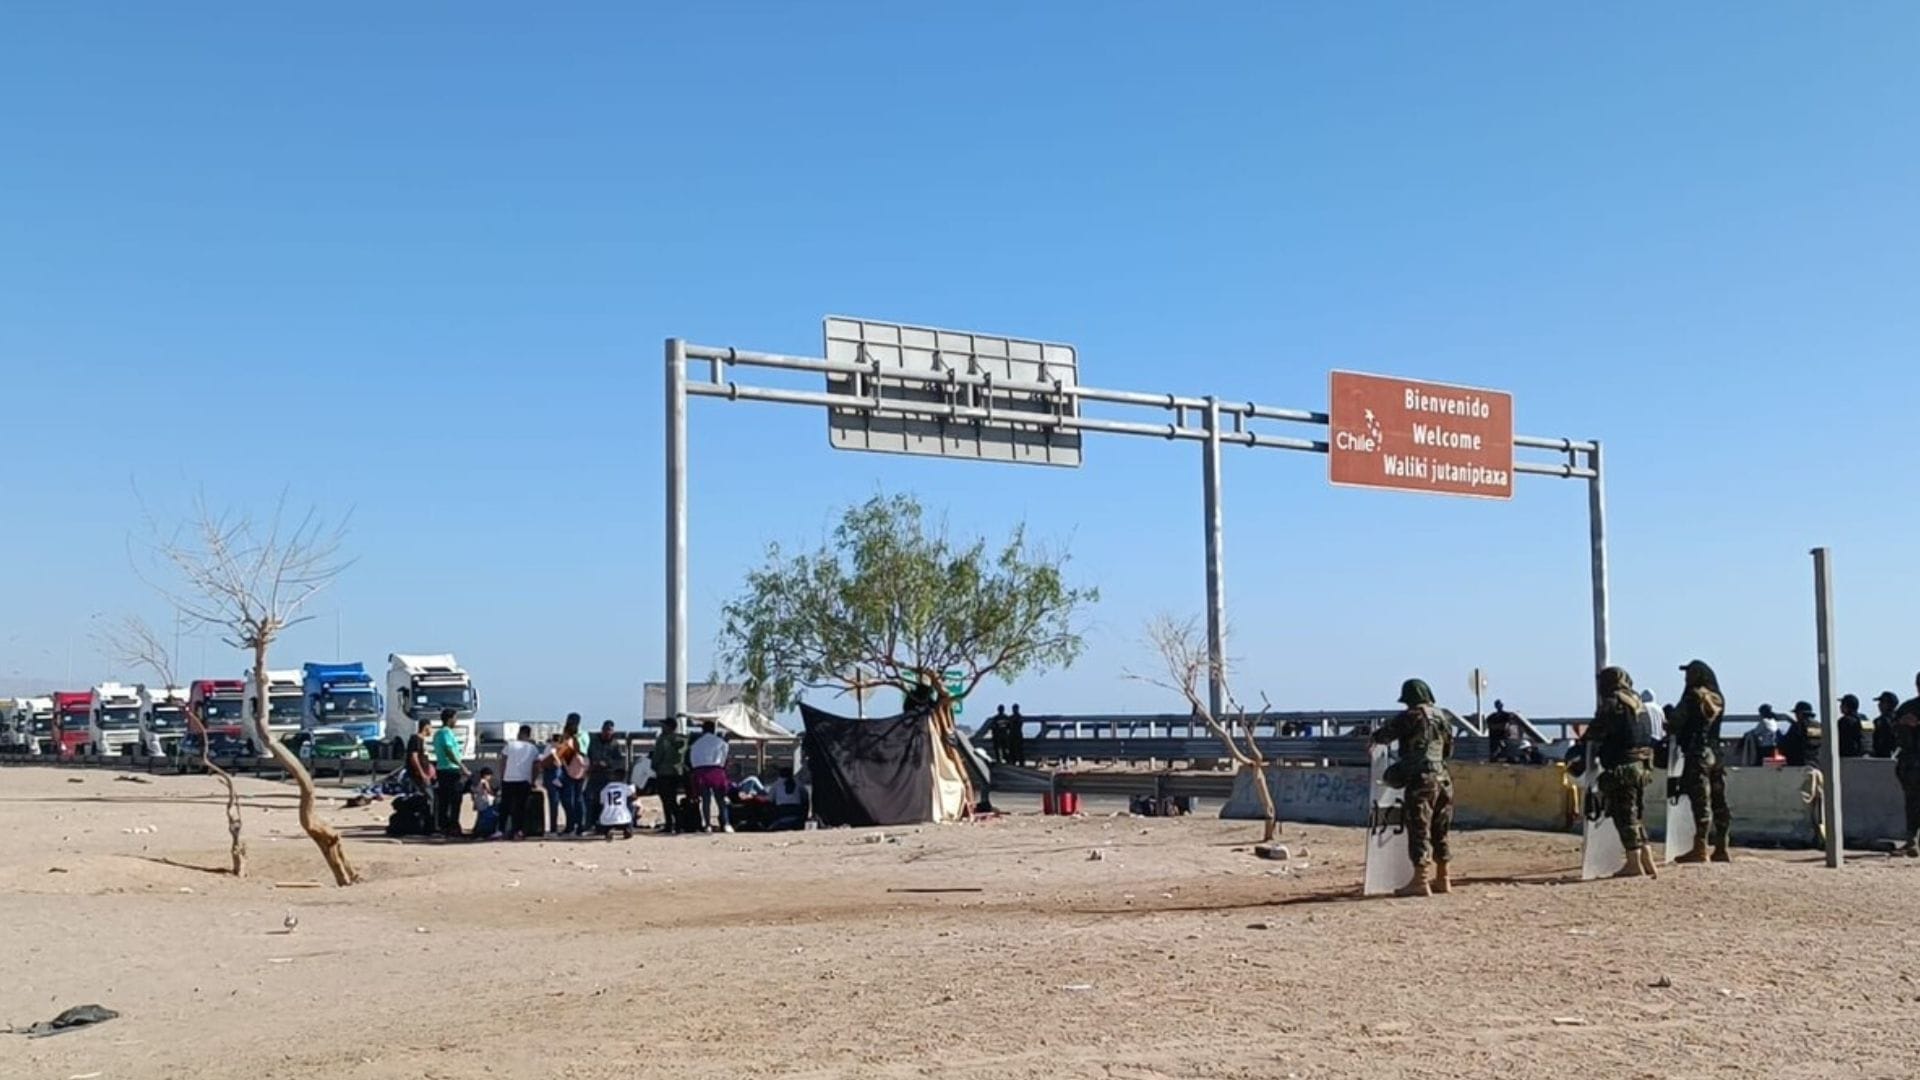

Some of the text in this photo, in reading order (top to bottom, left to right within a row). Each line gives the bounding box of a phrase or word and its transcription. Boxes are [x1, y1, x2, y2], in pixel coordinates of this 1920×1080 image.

[1405, 388, 1490, 418] Bienvenido
[1336, 431, 1375, 452] Chile
[1412, 423, 1481, 450] Welcome
[1383, 454, 1508, 487] Waliki jutaniptaxa
[607, 791, 622, 806] 12
